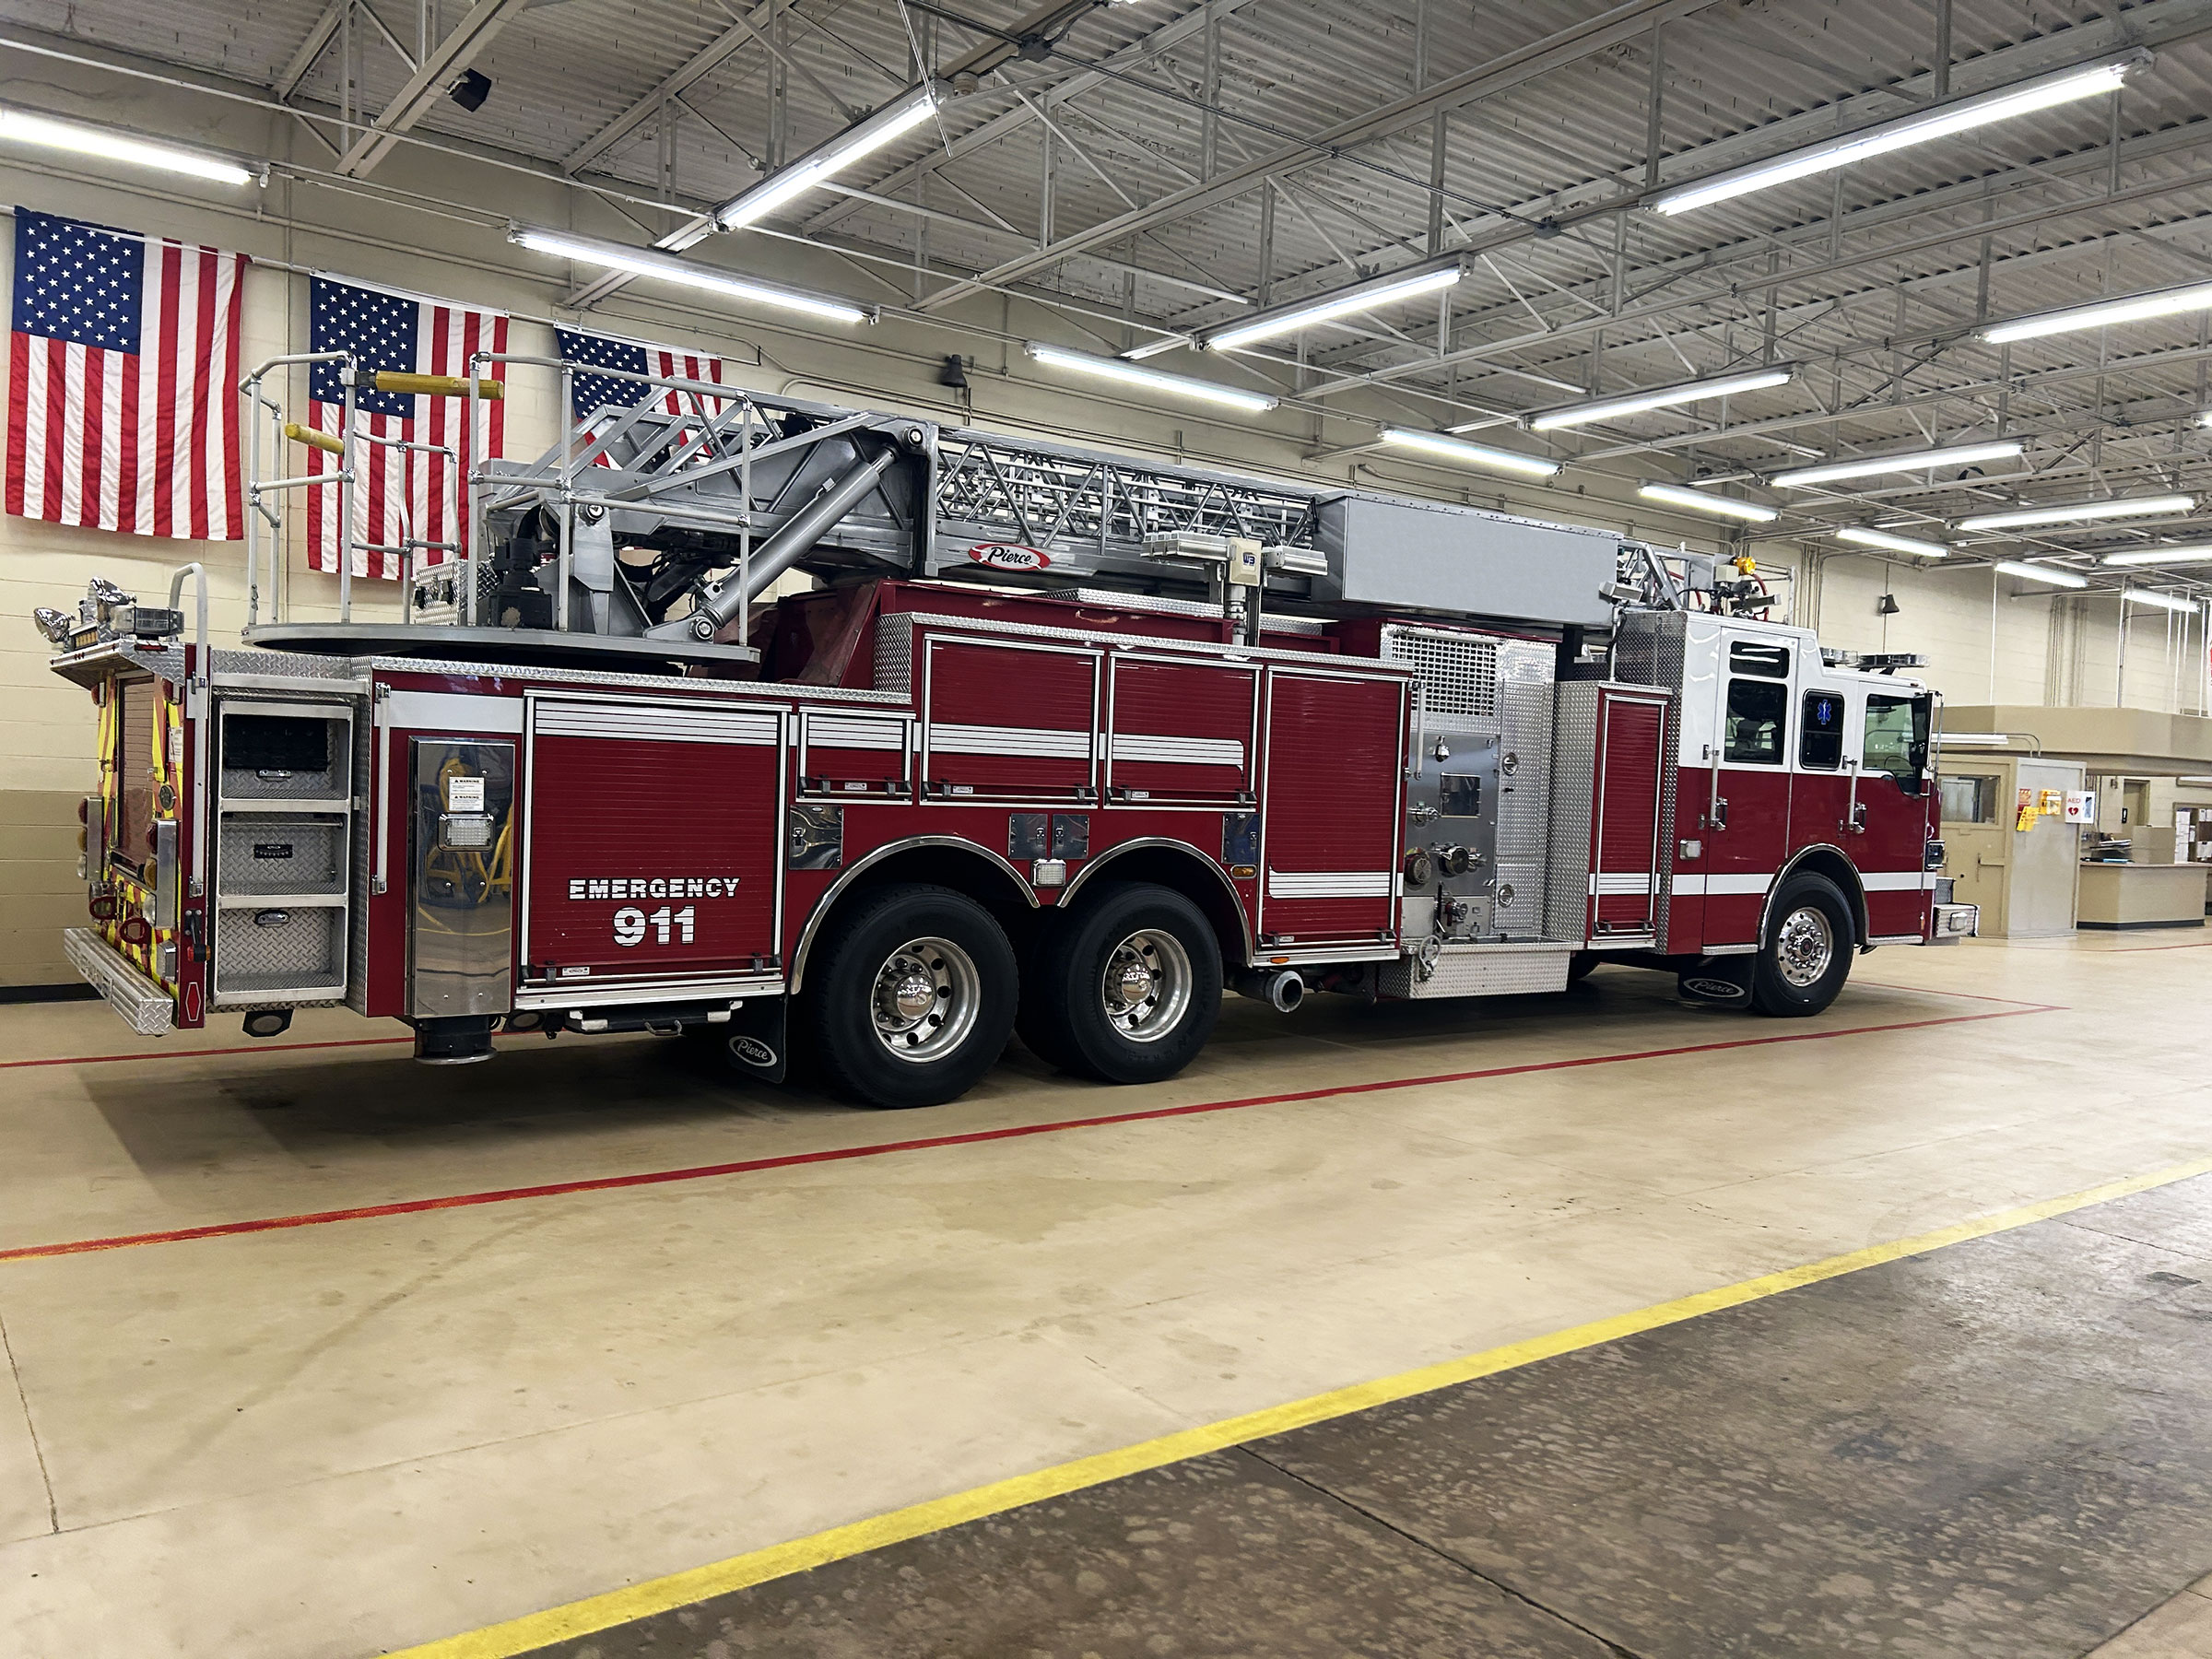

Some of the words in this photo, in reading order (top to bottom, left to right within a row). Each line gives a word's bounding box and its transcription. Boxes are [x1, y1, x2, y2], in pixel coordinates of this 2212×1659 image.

[987, 547, 1032, 564] Pierce
[569, 877, 740, 900] EMERGENCY
[613, 905, 695, 947] 911
[1694, 980, 1734, 994] Pierce
[737, 1039, 768, 1060] Pierce
